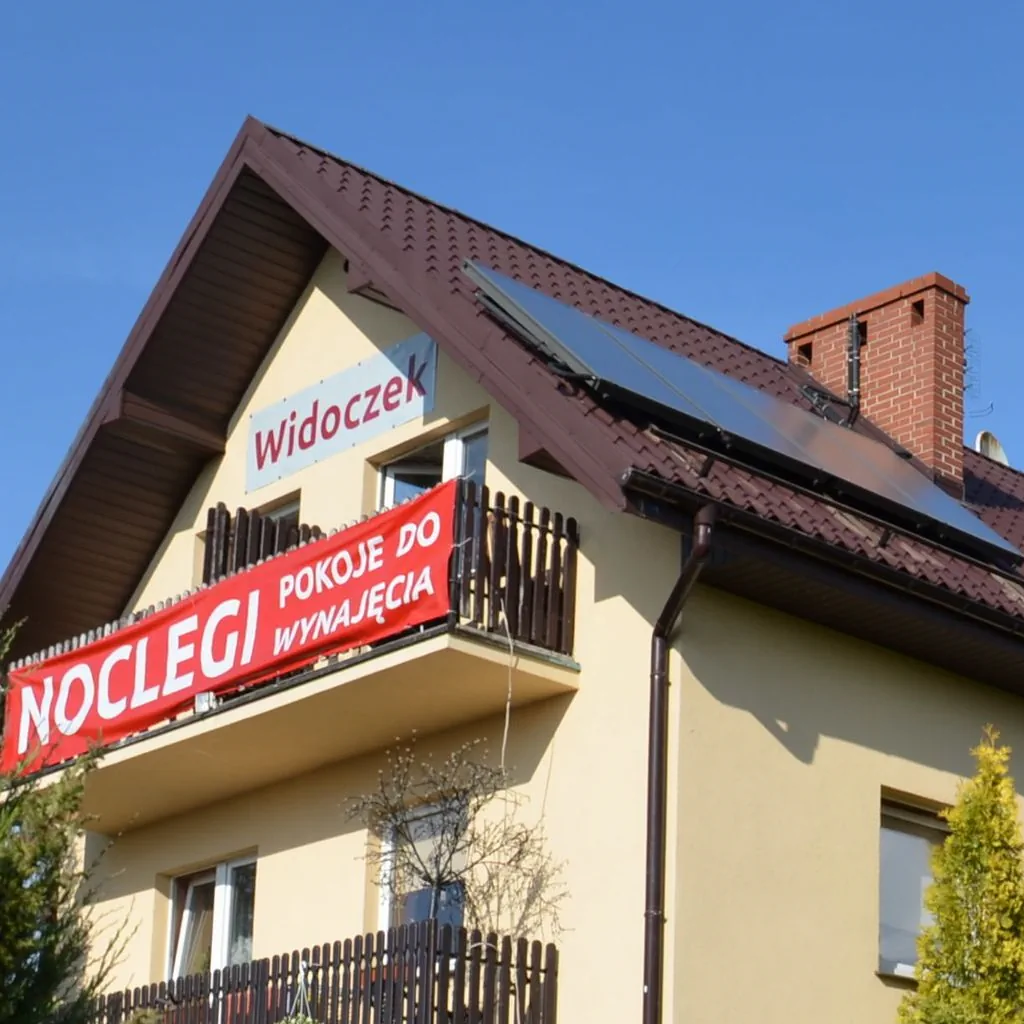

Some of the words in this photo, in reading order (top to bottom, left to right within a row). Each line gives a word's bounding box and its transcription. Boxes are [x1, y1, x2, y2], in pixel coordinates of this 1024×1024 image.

[254, 353, 428, 471] Widoczek
[273, 566, 434, 656] WYNAJĘCIA
[279, 536, 384, 608] POKOJE
[397, 511, 441, 559] DO
[17, 590, 260, 754] NOCLEGI
